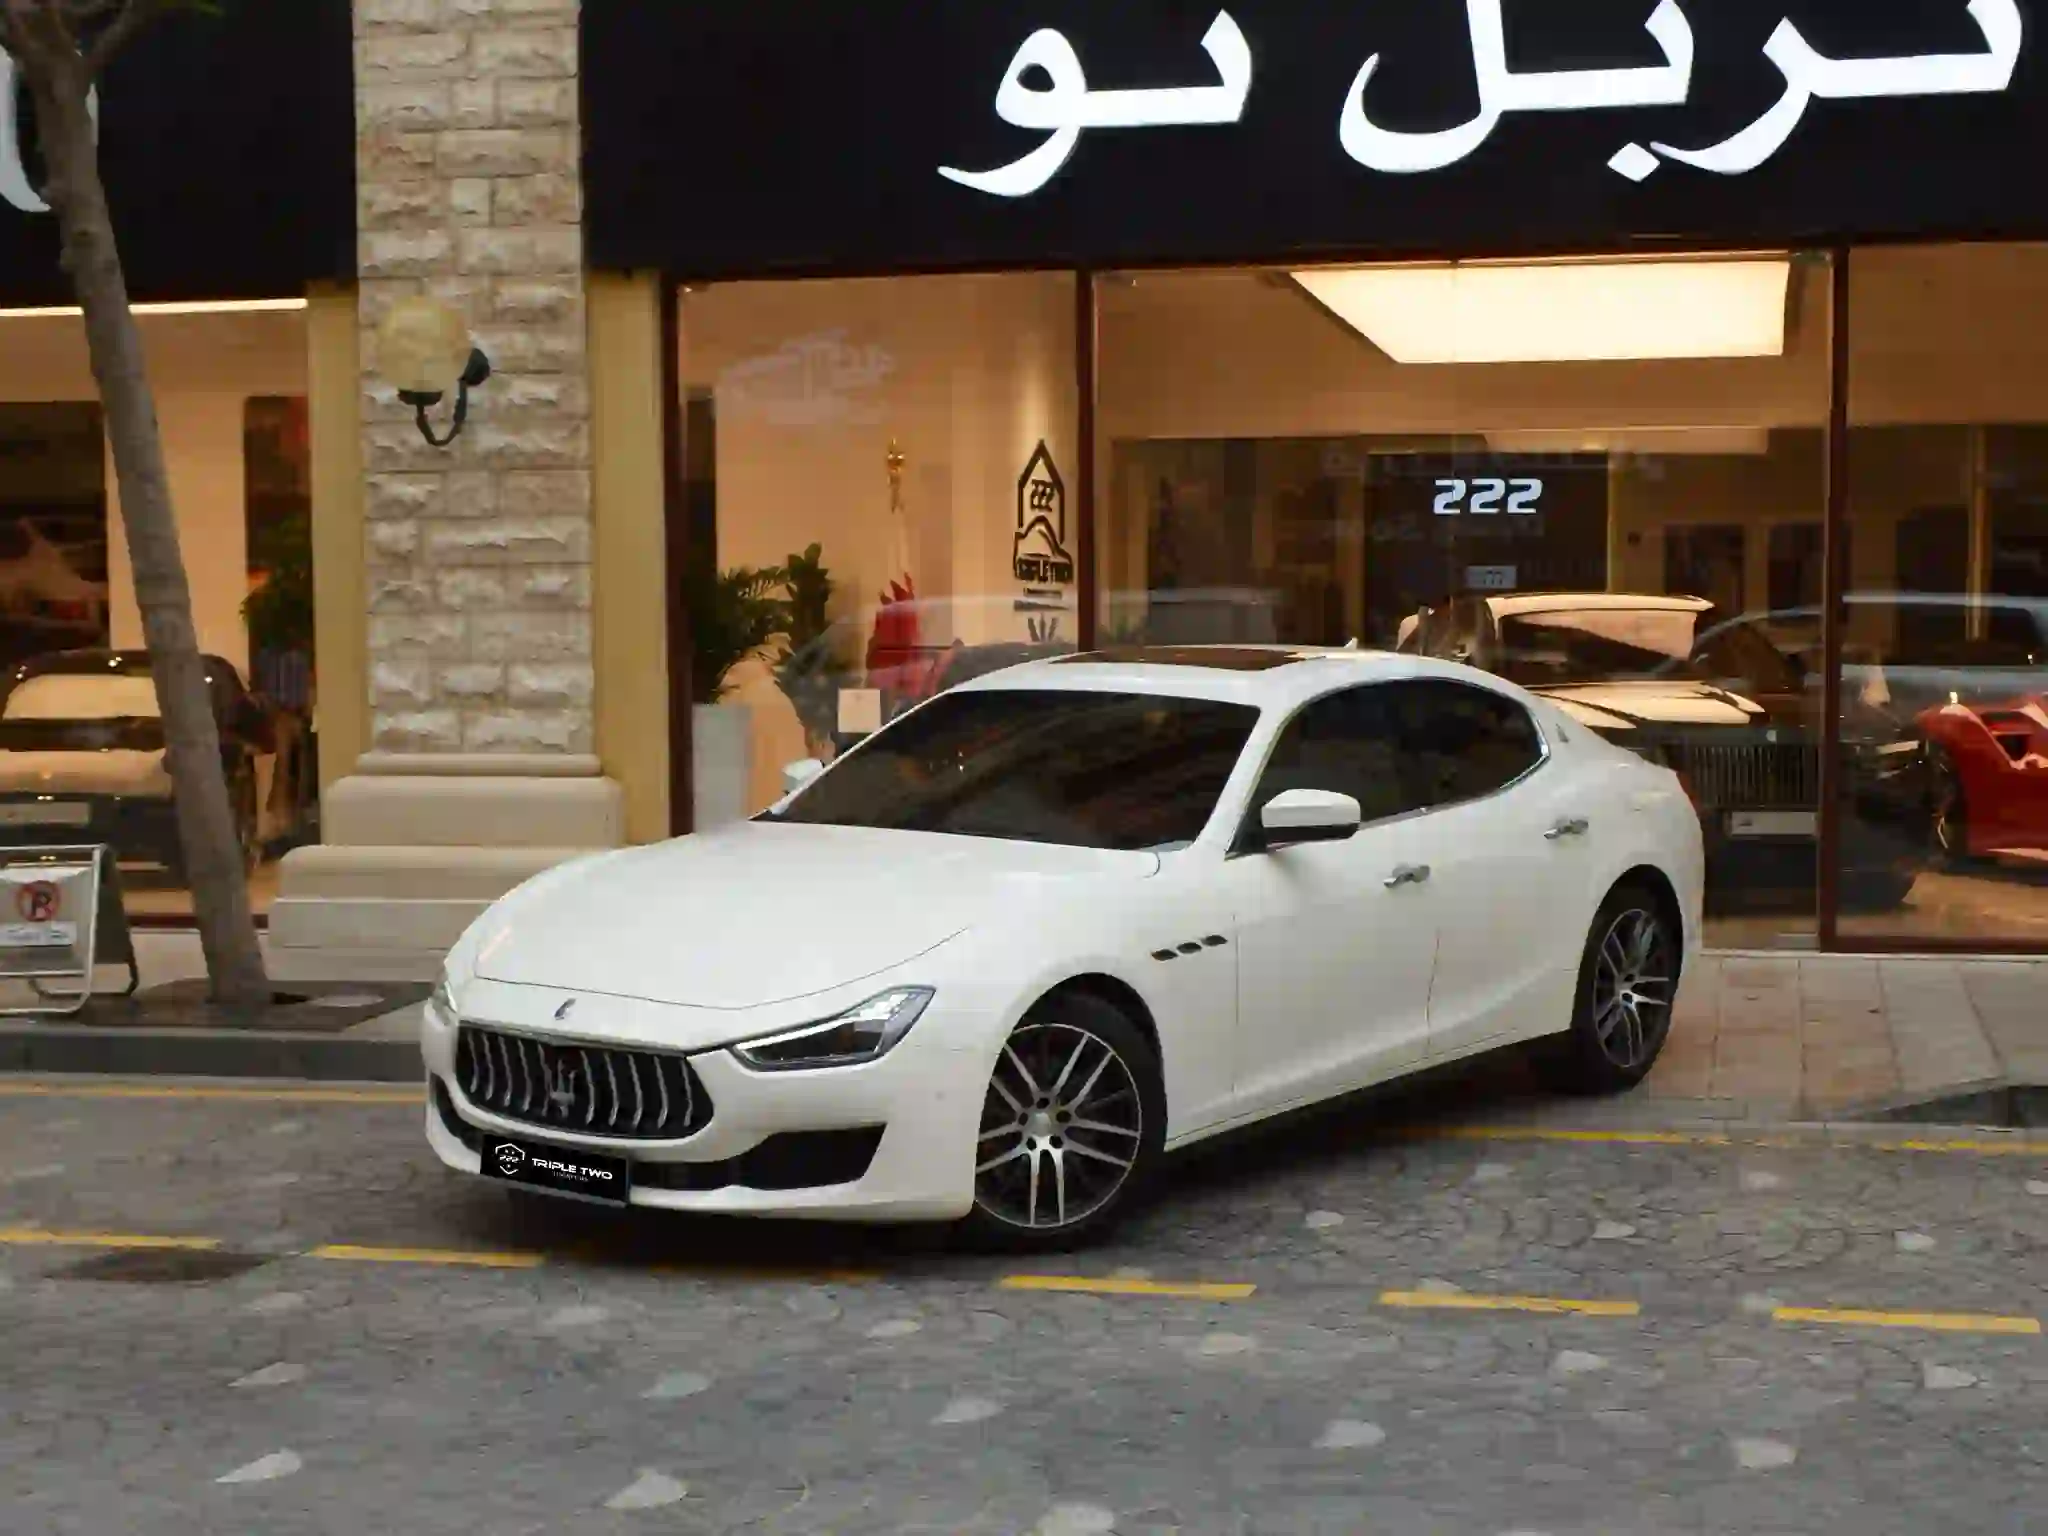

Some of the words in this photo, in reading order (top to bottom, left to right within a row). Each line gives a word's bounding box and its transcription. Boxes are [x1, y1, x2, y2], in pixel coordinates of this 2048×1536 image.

[1433, 478, 1543, 514] 222
[531, 1157, 577, 1174] TRIPLE
[579, 1166, 613, 1181] TWO
